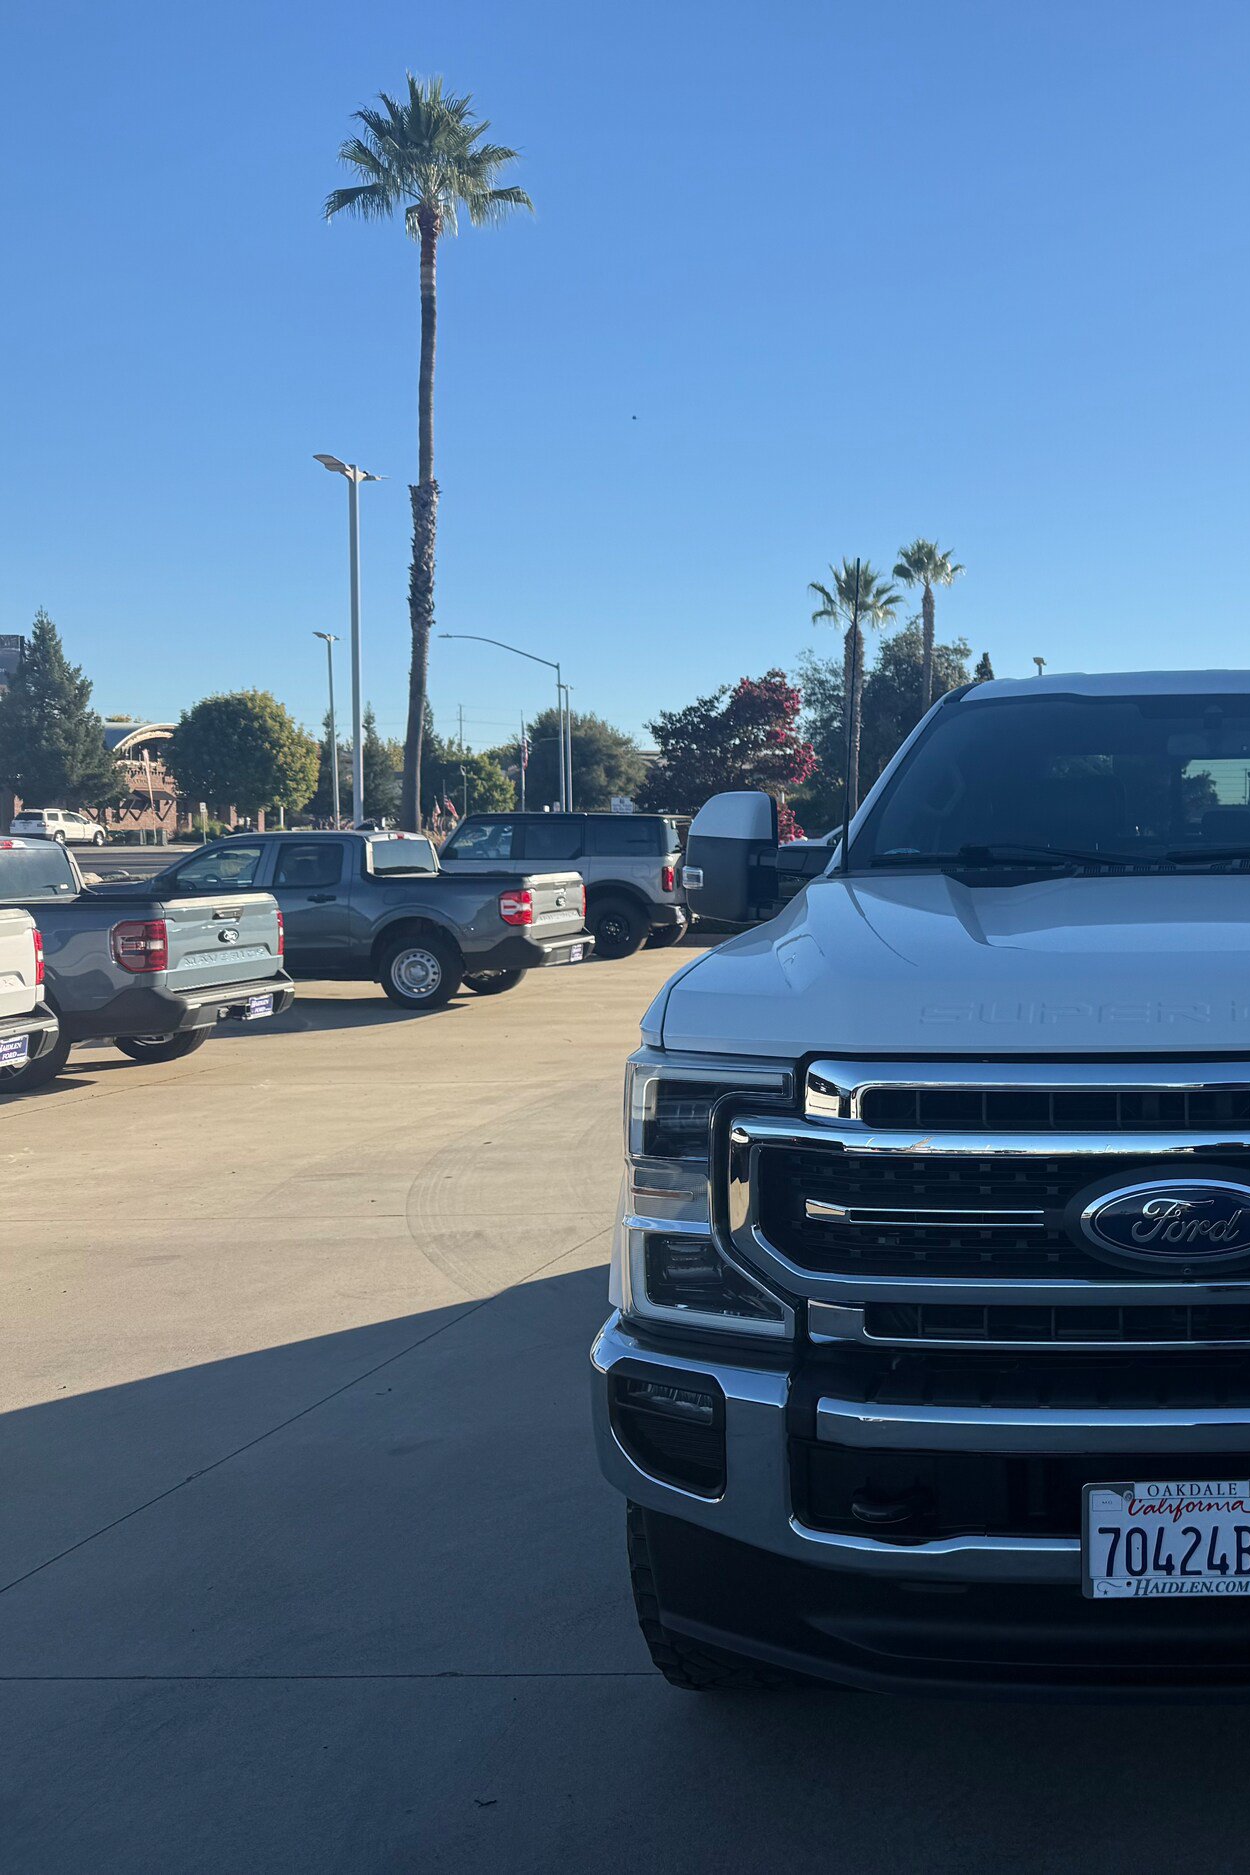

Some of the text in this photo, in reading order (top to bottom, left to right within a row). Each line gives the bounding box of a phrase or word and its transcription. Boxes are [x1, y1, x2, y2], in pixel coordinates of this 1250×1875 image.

[919, 1000, 1212, 1025] SUPER
[1131, 1197, 1242, 1243] Ford
[1147, 1482, 1238, 1497] OAKDALE
[1133, 1577, 1250, 1597] HAIDLEN.COM
